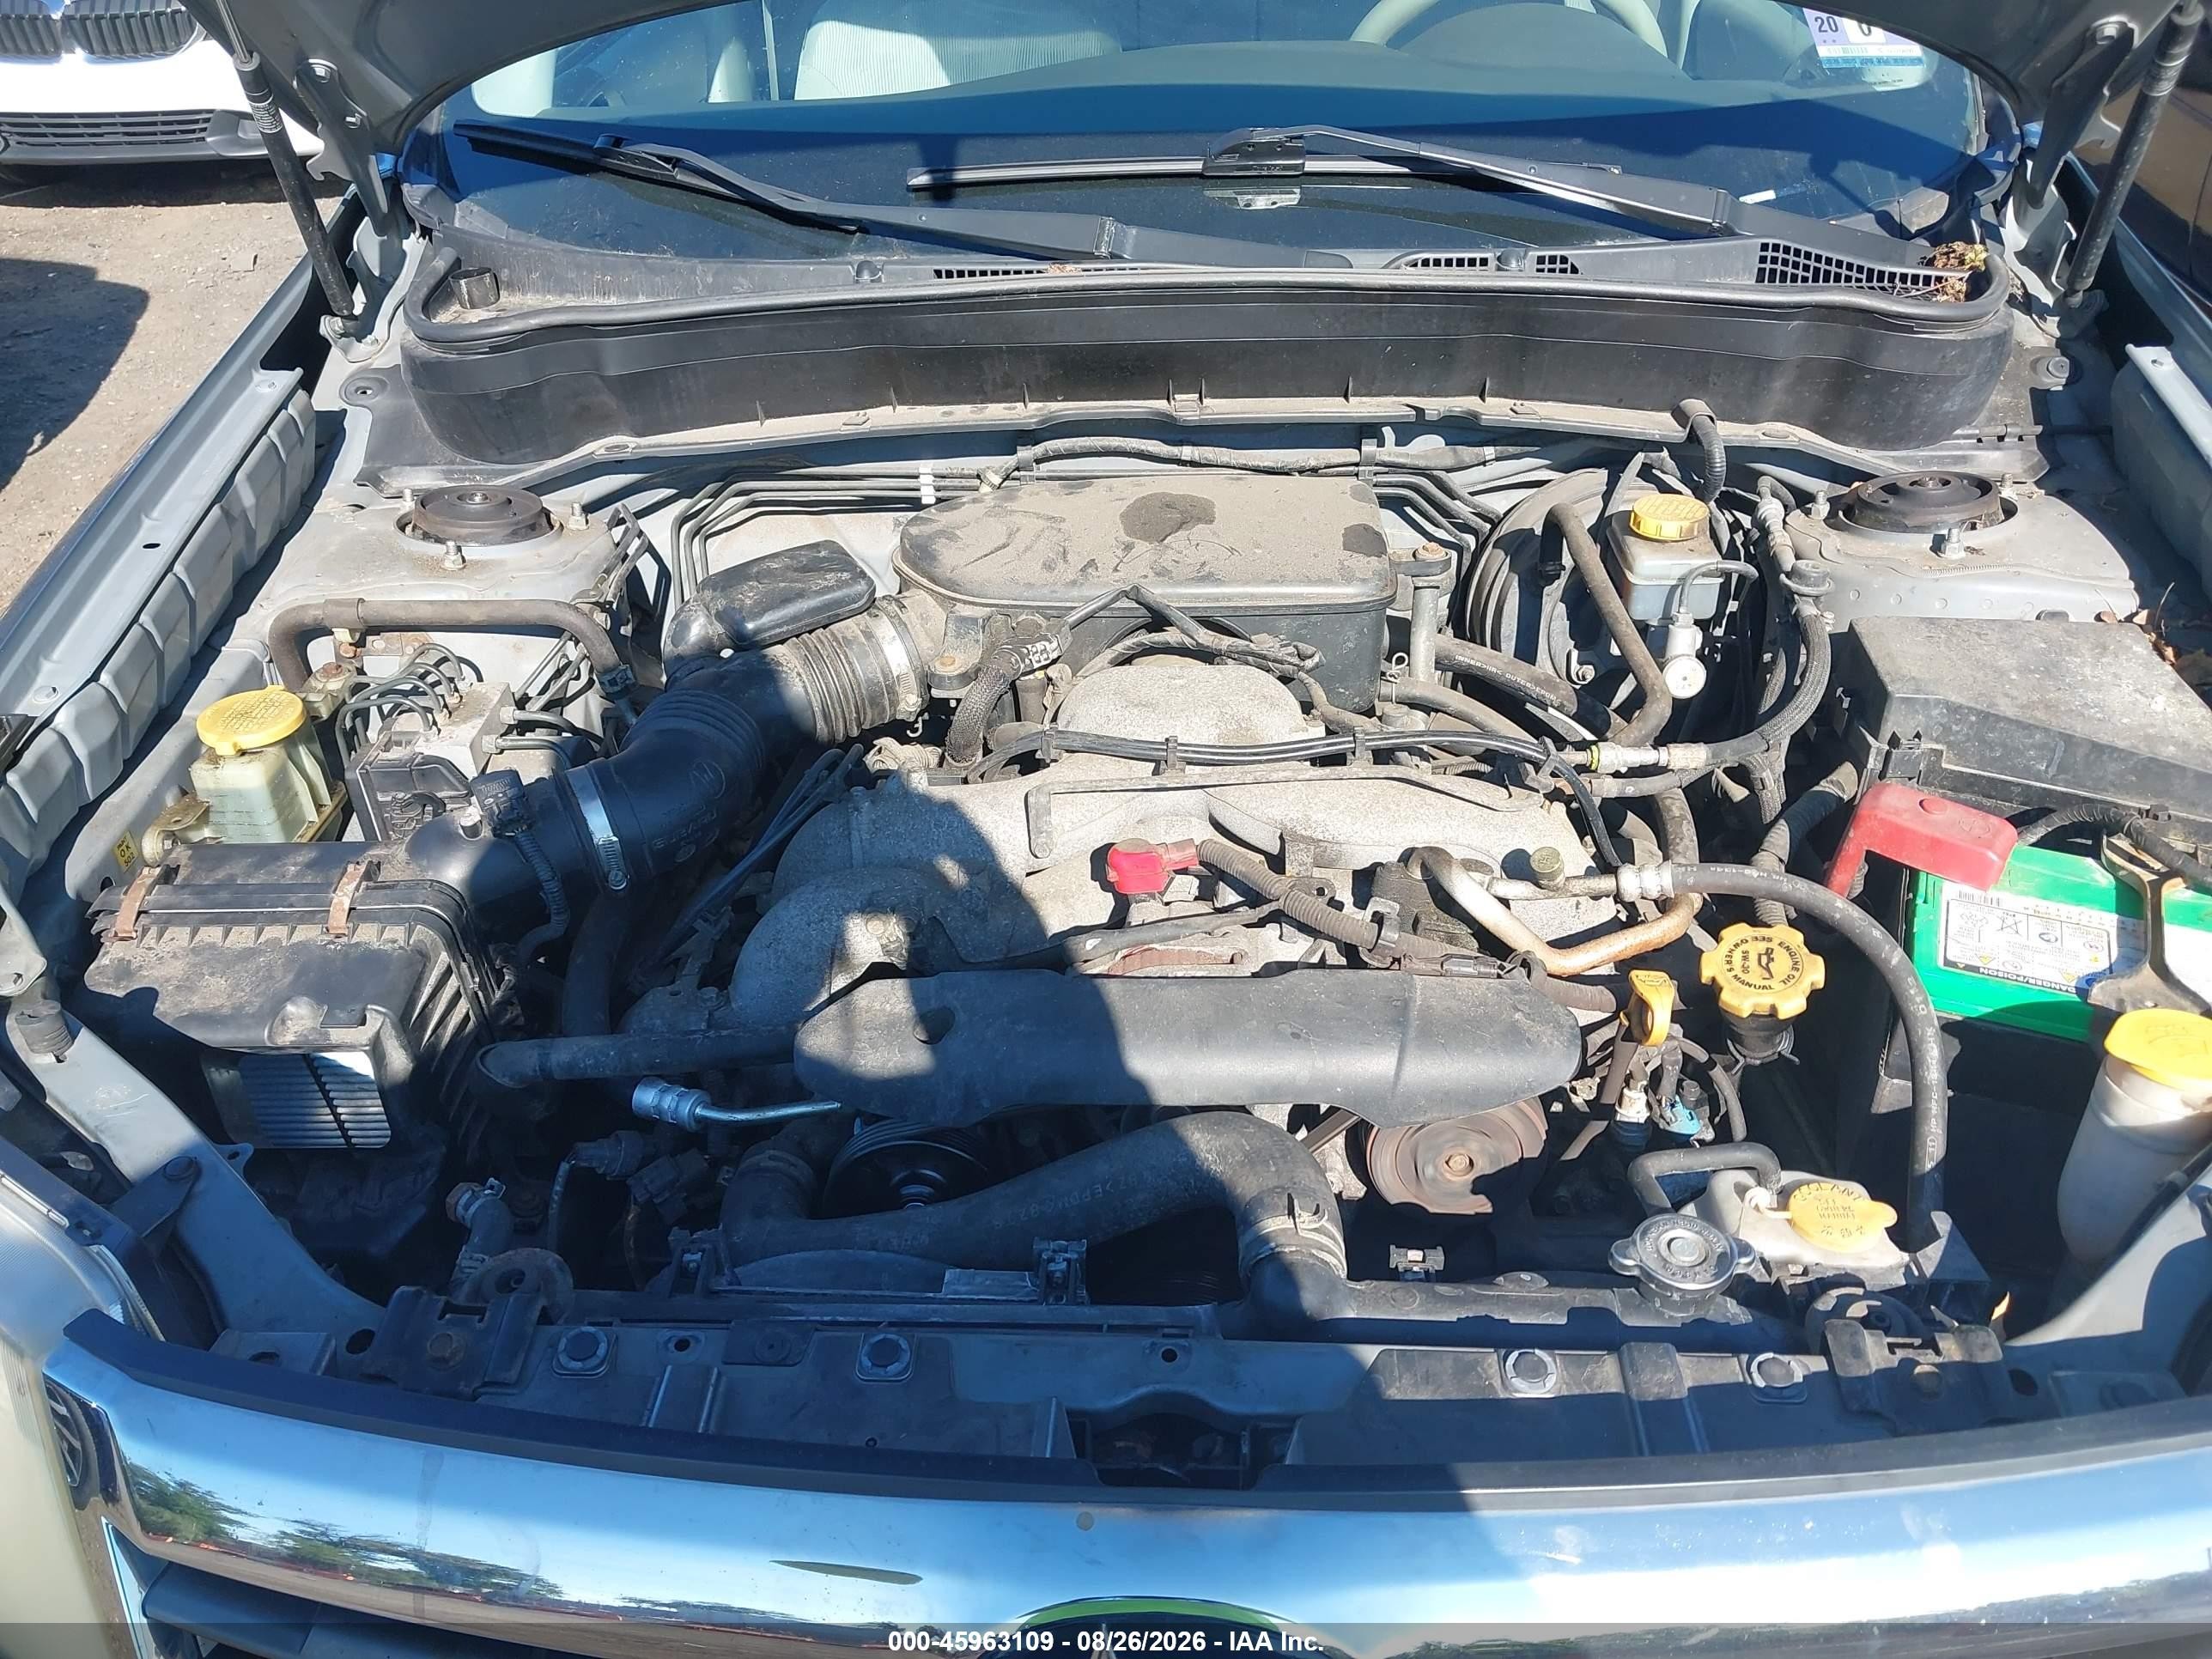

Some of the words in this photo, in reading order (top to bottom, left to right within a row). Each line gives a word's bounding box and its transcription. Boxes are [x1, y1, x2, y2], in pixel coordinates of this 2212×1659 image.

[1814, 15, 1839, 33] 20
[1778, 941, 1800, 973] ENGINE
[1731, 974, 1775, 990] MANUAL
[1779, 974, 1796, 985] OIL
[1978, 967, 2076, 994] DANGER/POISON
